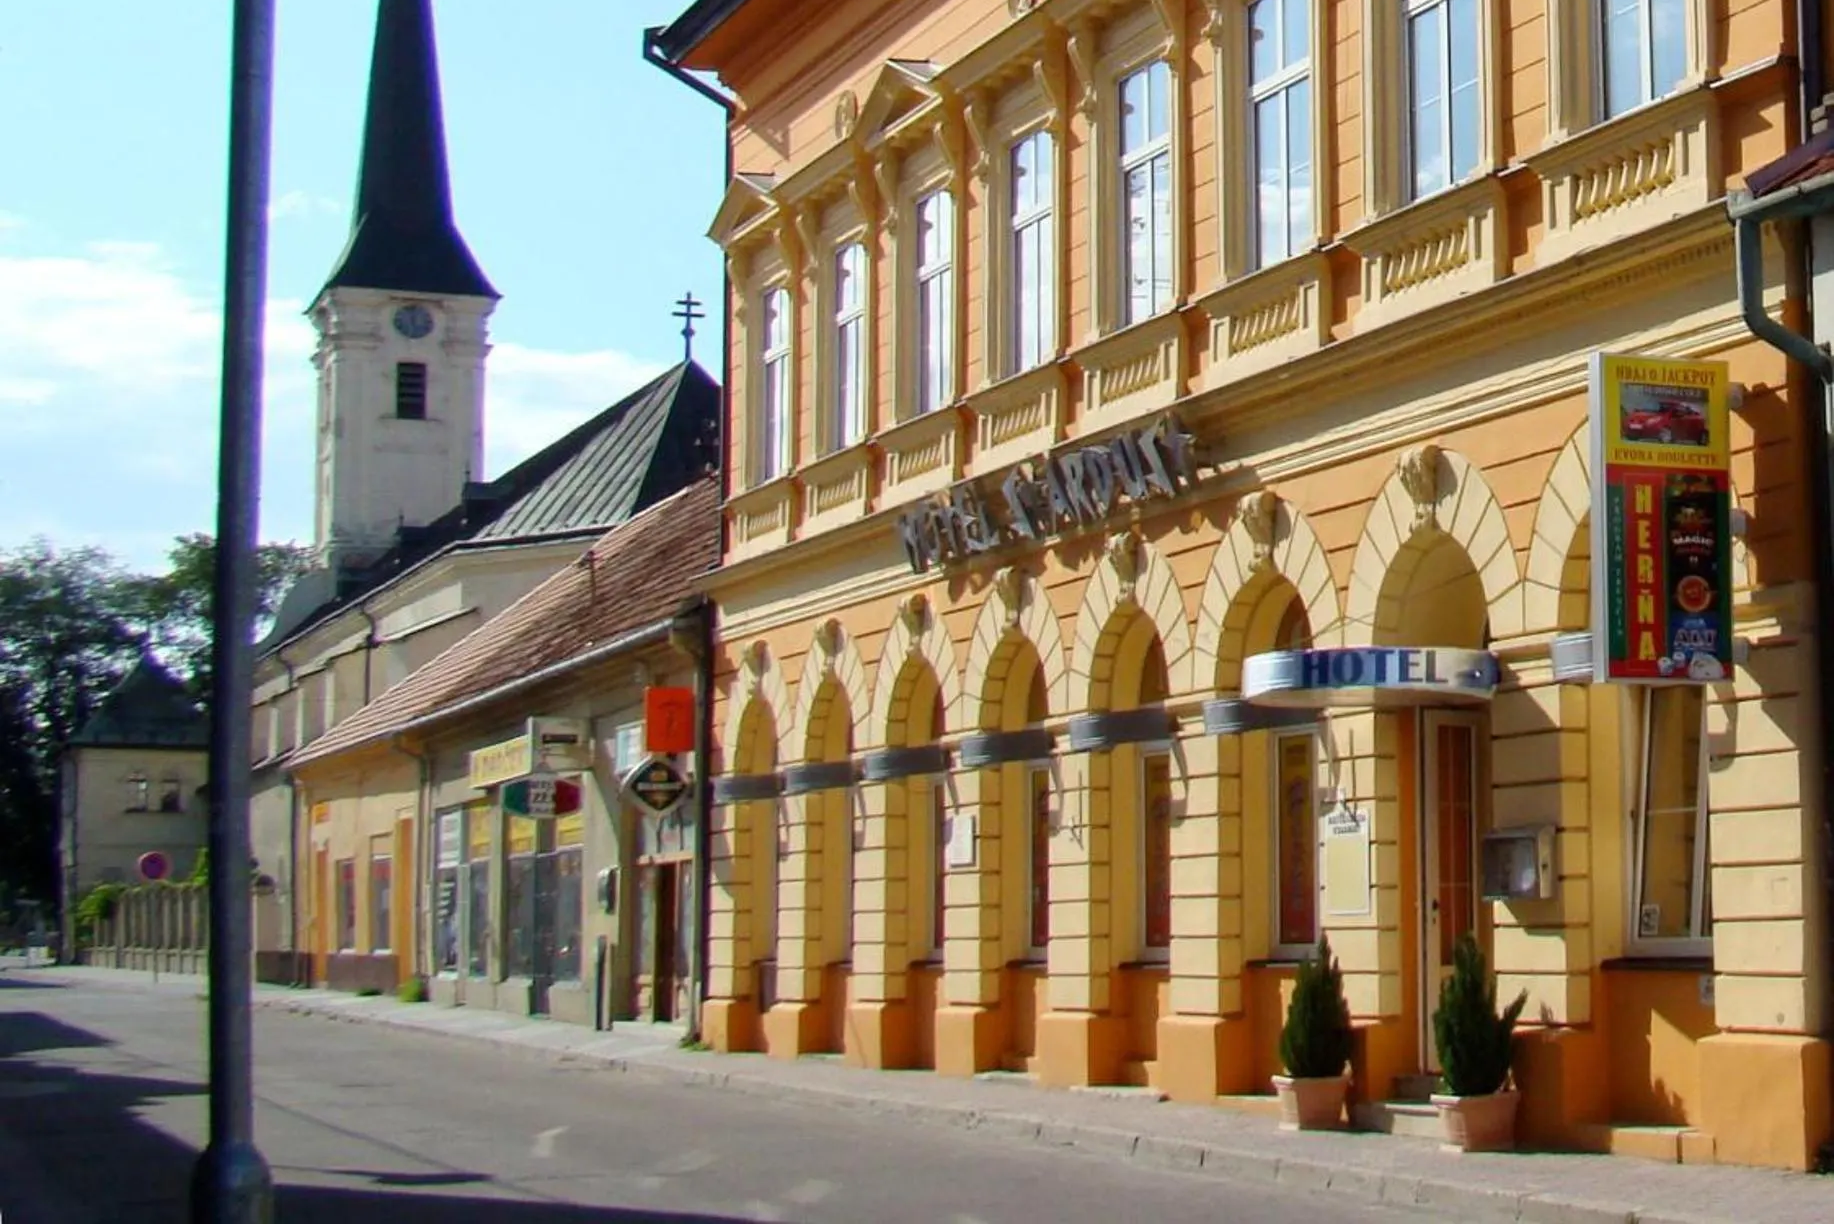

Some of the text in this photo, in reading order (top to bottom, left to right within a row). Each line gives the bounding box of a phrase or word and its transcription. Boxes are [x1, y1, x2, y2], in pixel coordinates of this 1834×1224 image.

[1662, 366, 1717, 386] JACKPOT
[899, 483, 1000, 575] HOTEL
[1634, 484, 1656, 661] HERŇA
[1302, 649, 1449, 688] HOTEL
